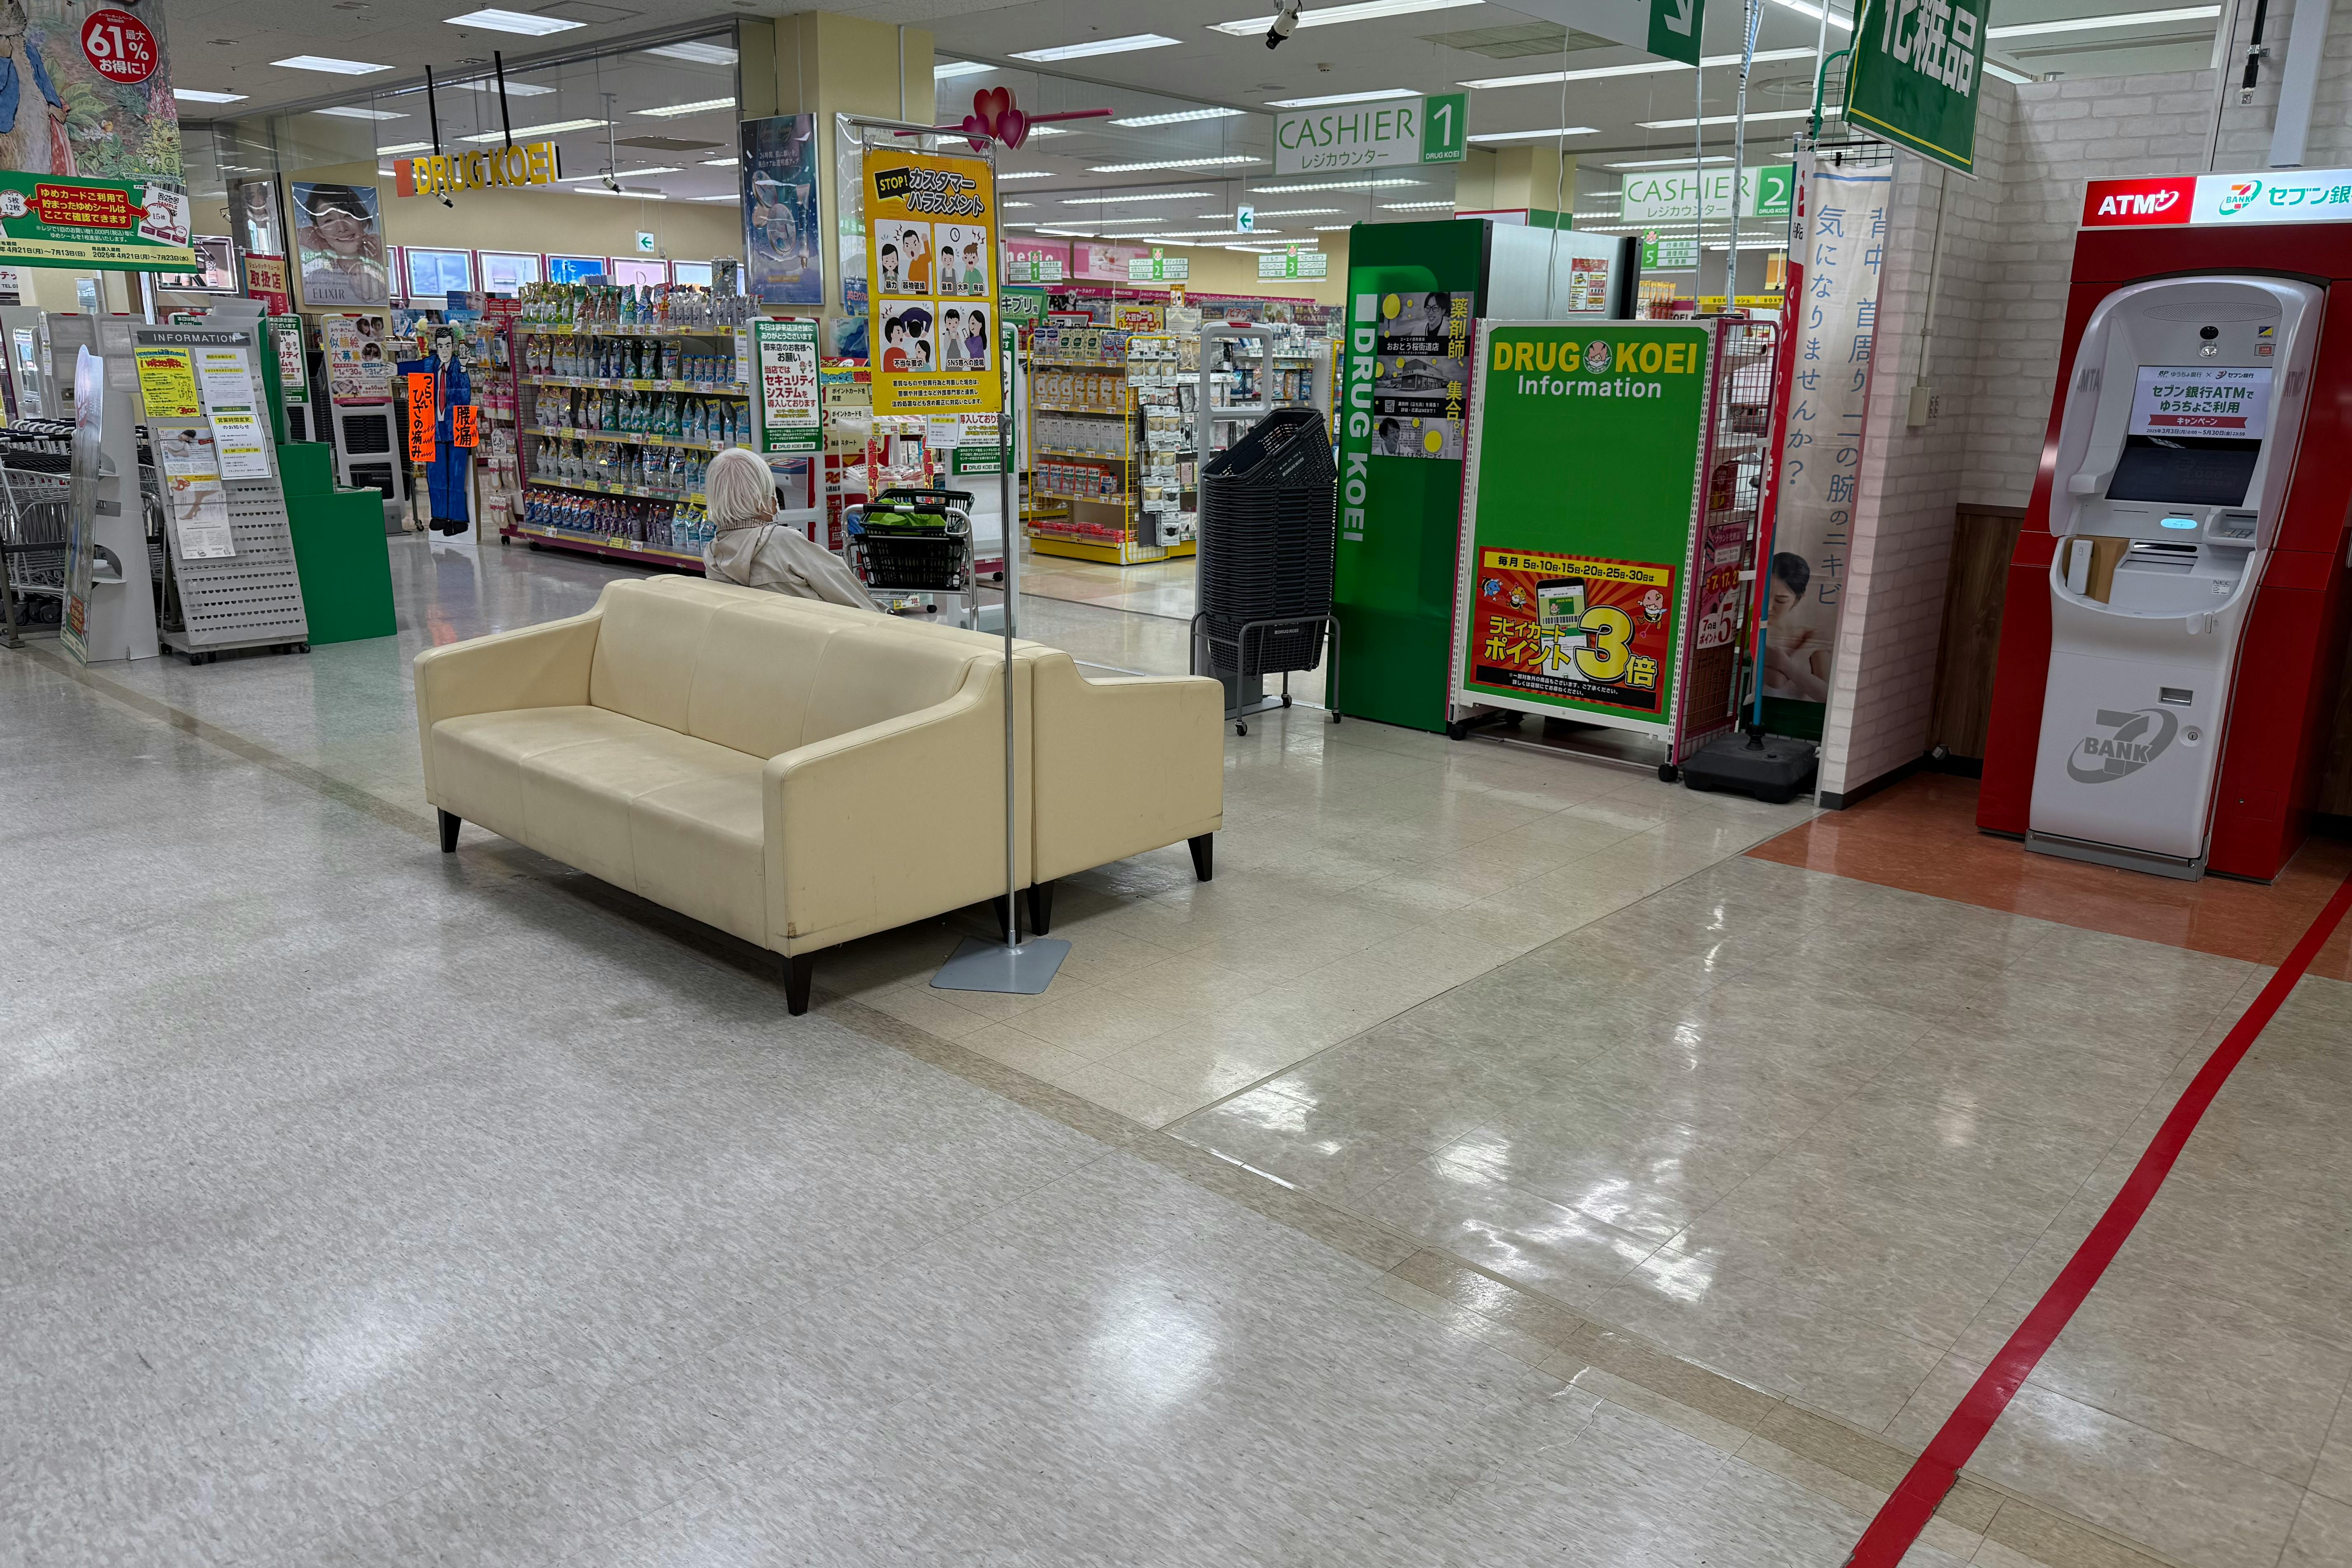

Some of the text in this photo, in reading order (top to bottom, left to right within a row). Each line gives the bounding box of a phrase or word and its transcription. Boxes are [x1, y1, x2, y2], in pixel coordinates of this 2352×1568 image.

[126, 29, 147, 41] 最大
[1881, 0, 1977, 98] 化粧品
[99, 58, 147, 75] お得に!
[1279, 103, 1452, 149] CASHIER 1
[1302, 149, 1389, 169] レジカウンター
[413, 141, 557, 195] DRUG KOEI
[879, 175, 908, 191] STOP!
[909, 167, 976, 192] カスタマー
[41, 188, 124, 203] ゆめカードご利用で
[1628, 176, 1787, 206] CASHIER 2
[2268, 185, 2352, 205] セブン銀
[42, 199, 126, 213] 貯まったゆめシールは
[907, 191, 985, 217] ハラスメント
[2098, 193, 2156, 216] ATM
[44, 210, 127, 224] ここで確認できます
[1647, 205, 1727, 218] レジカウンター
[1864, 207, 1886, 275] 背中
[1645, 250, 1654, 264] 5
[1033, 268, 1037, 278] 1
[1155, 265, 1161, 275] 2
[1288, 262, 1295, 273] 3
[250, 269, 281, 289] 取扱店
[886, 281, 897, 289] 暴力
[313, 288, 345, 300] ELIXIR
[759, 324, 813, 332] 本日は御来店頂き誠に
[153, 333, 236, 343] INFORMATION
[329, 336, 360, 349] 似顔絵
[761, 332, 813, 341] ありがとうございます
[1386, 342, 1440, 351] おおとう桜街道店
[1787, 204, 1846, 485] 気になりませんか？
[1848, 297, 1876, 392] 首周り
[331, 350, 362, 362] 大募集
[777, 352, 801, 363] お願い
[894, 359, 924, 367] 不当な要求
[947, 359, 985, 367] SNS等への投稿
[1493, 342, 1697, 374] DRUG KOEI
[764, 366, 791, 374] 当店では
[765, 375, 815, 386] セキュリティ
[1518, 375, 1661, 398] Information
[423, 375, 433, 409] つらい
[766, 387, 808, 399] システムを
[2152, 385, 2254, 399] セブン銀行ATMで
[767, 399, 817, 408] 導入しております
[1445, 380, 1462, 429] 集合。
[2160, 400, 2240, 413] ゆうちょご利用
[455, 406, 472, 447] 腰痛
[2177, 417, 2218, 425] キャンペーン
[1342, 328, 1375, 542] DRUG KOEI
[1818, 414, 1863, 605] 二の腕のニキビ
[1498, 555, 1518, 567] 毎月
[1718, 602, 1733, 643] 5
[1699, 632, 1717, 644] ポイント
[1484, 636, 1571, 670] ポイント
[1573, 604, 1659, 690] 3 倍
[2084, 736, 2153, 763] BANK
